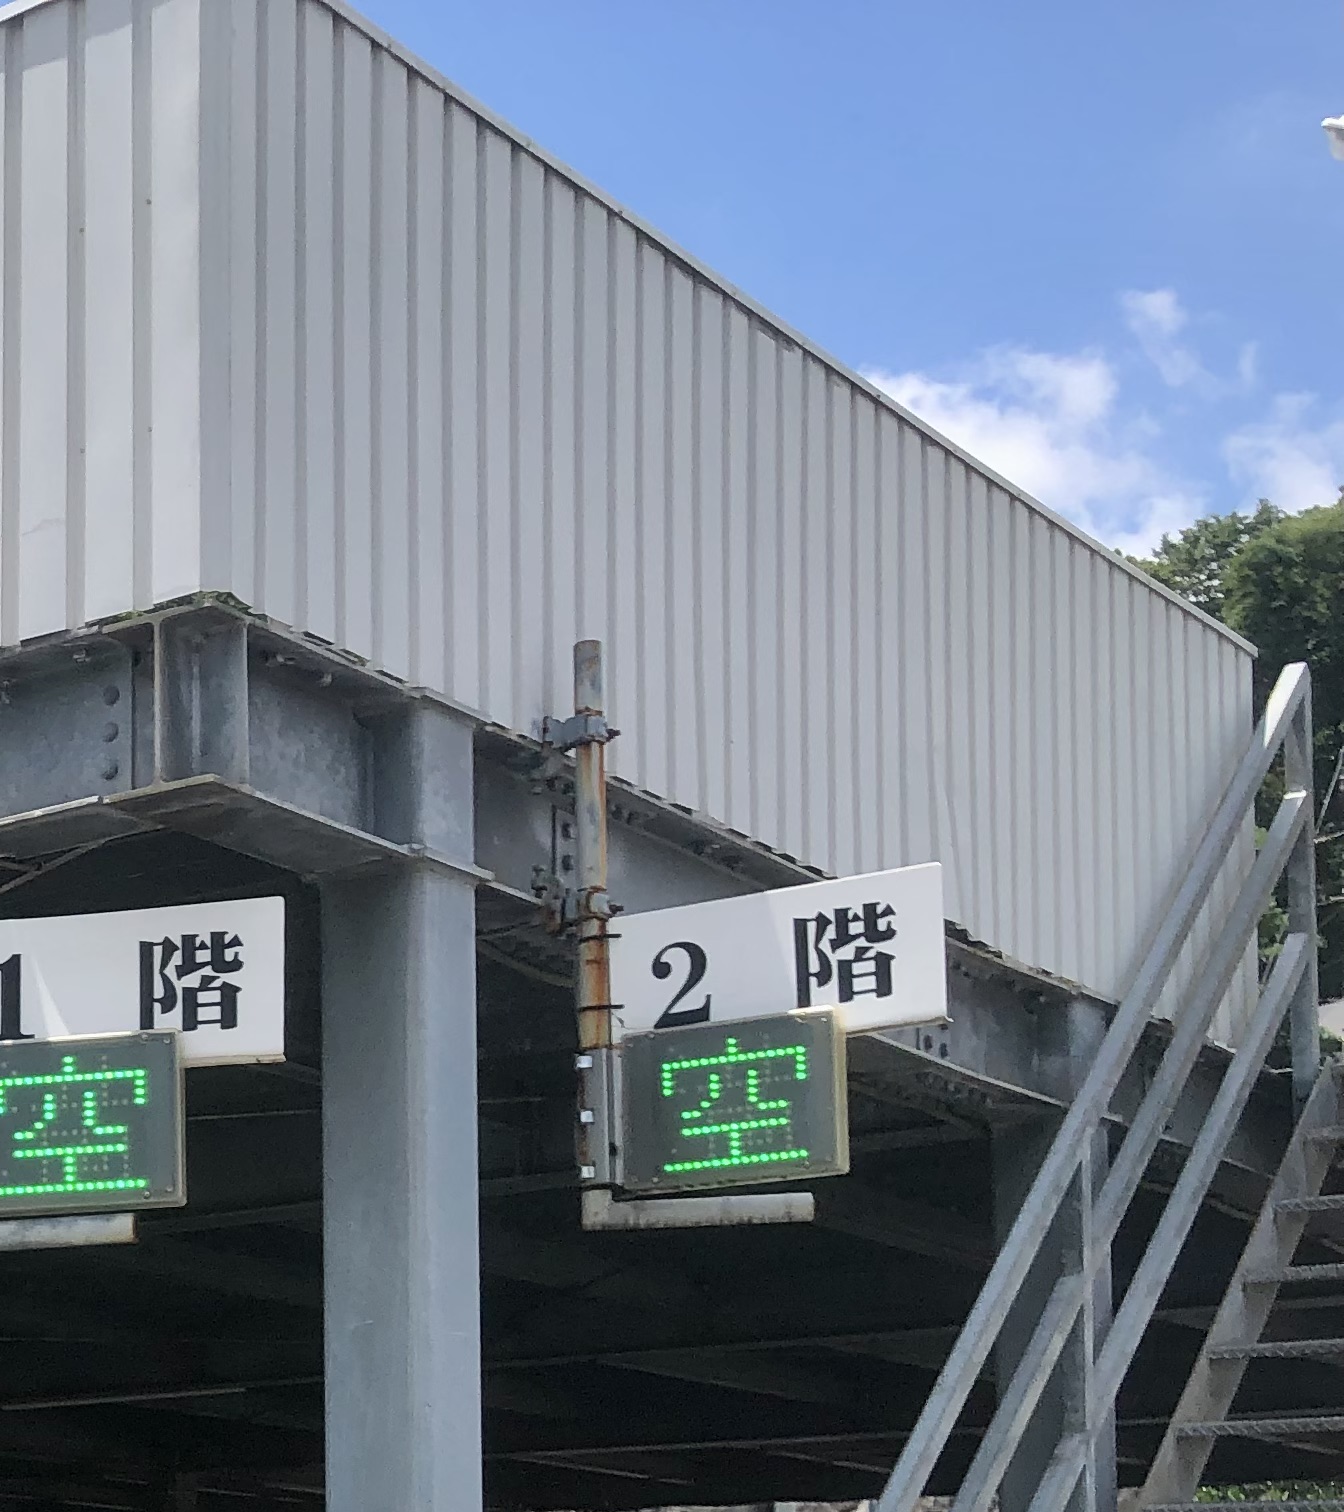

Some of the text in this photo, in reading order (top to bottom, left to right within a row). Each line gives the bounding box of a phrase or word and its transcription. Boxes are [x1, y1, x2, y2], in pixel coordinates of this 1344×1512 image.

[139, 930, 244, 1032] 階
[793, 901, 897, 1008] 階
[662, 1037, 809, 1173] 空
